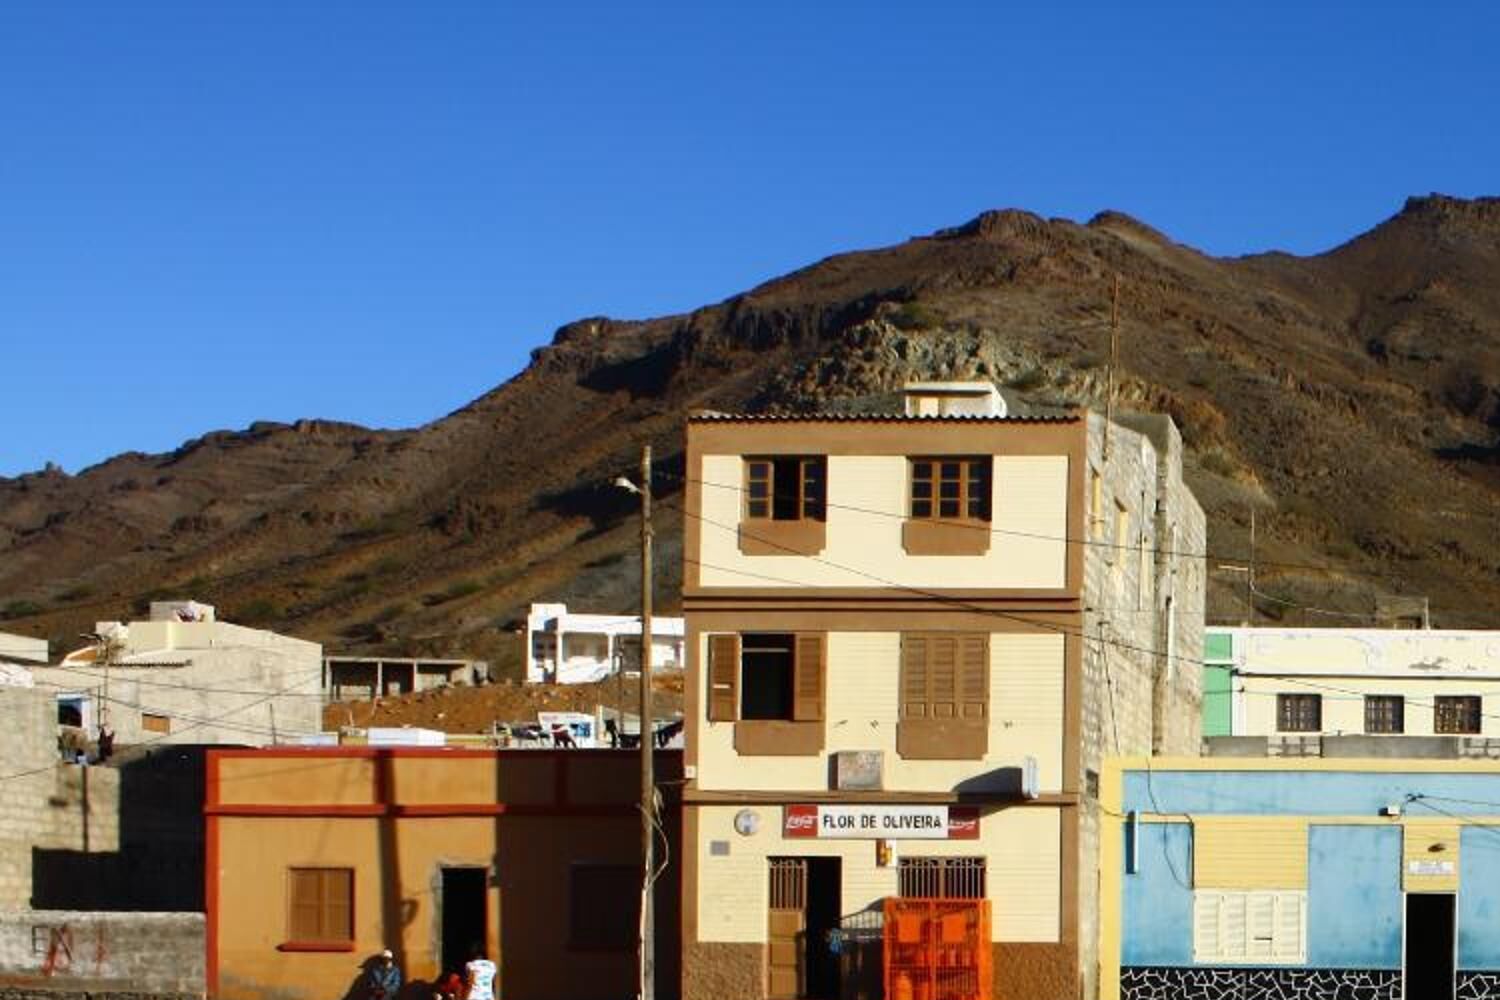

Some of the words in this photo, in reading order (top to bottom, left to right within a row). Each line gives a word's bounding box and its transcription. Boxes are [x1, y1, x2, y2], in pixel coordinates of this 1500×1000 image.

[823, 814, 855, 829] FLOR
[861, 814, 876, 829] DE
[883, 814, 942, 829] OLIVEIRA
